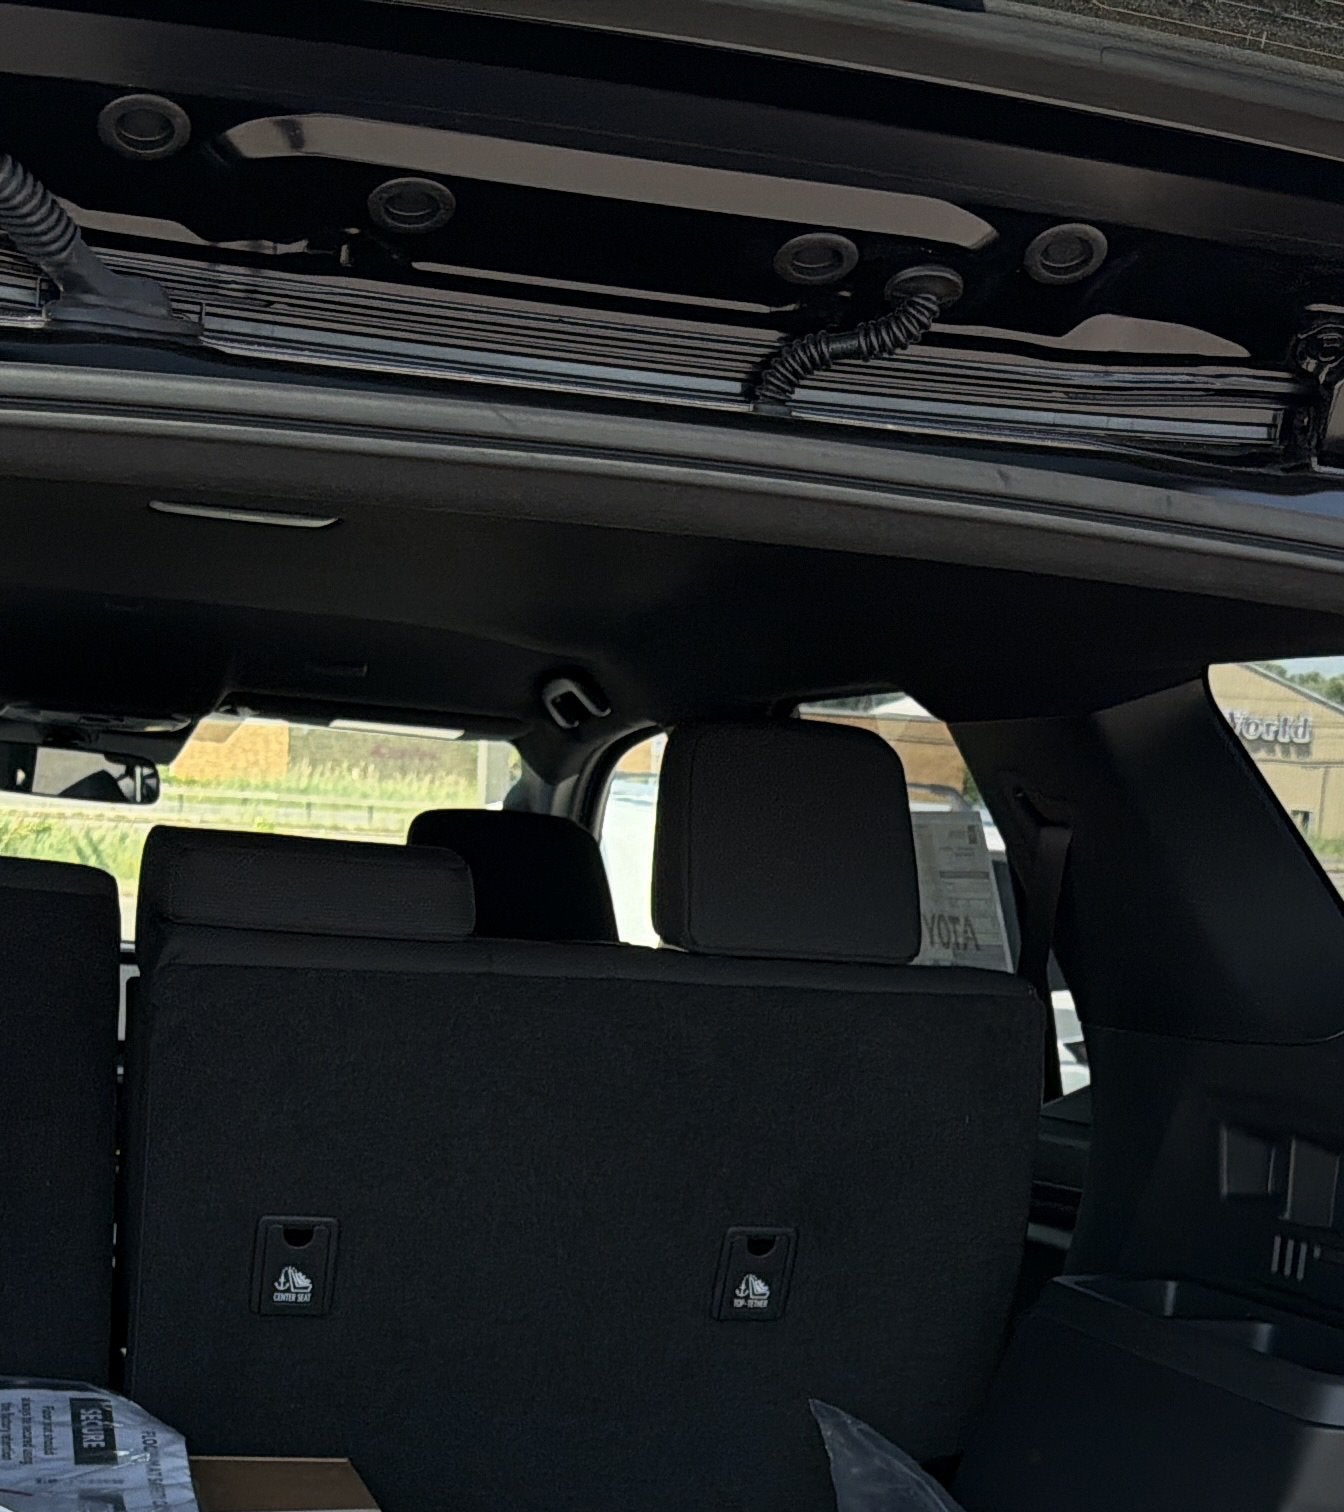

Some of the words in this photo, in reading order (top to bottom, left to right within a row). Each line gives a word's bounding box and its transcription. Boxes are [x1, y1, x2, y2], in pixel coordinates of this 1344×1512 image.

[922, 913, 981, 952] YOTA
[272, 1292, 296, 1302] CENTER
[297, 1292, 312, 1302] SEAT
[79, 1408, 106, 1449] SECURE
